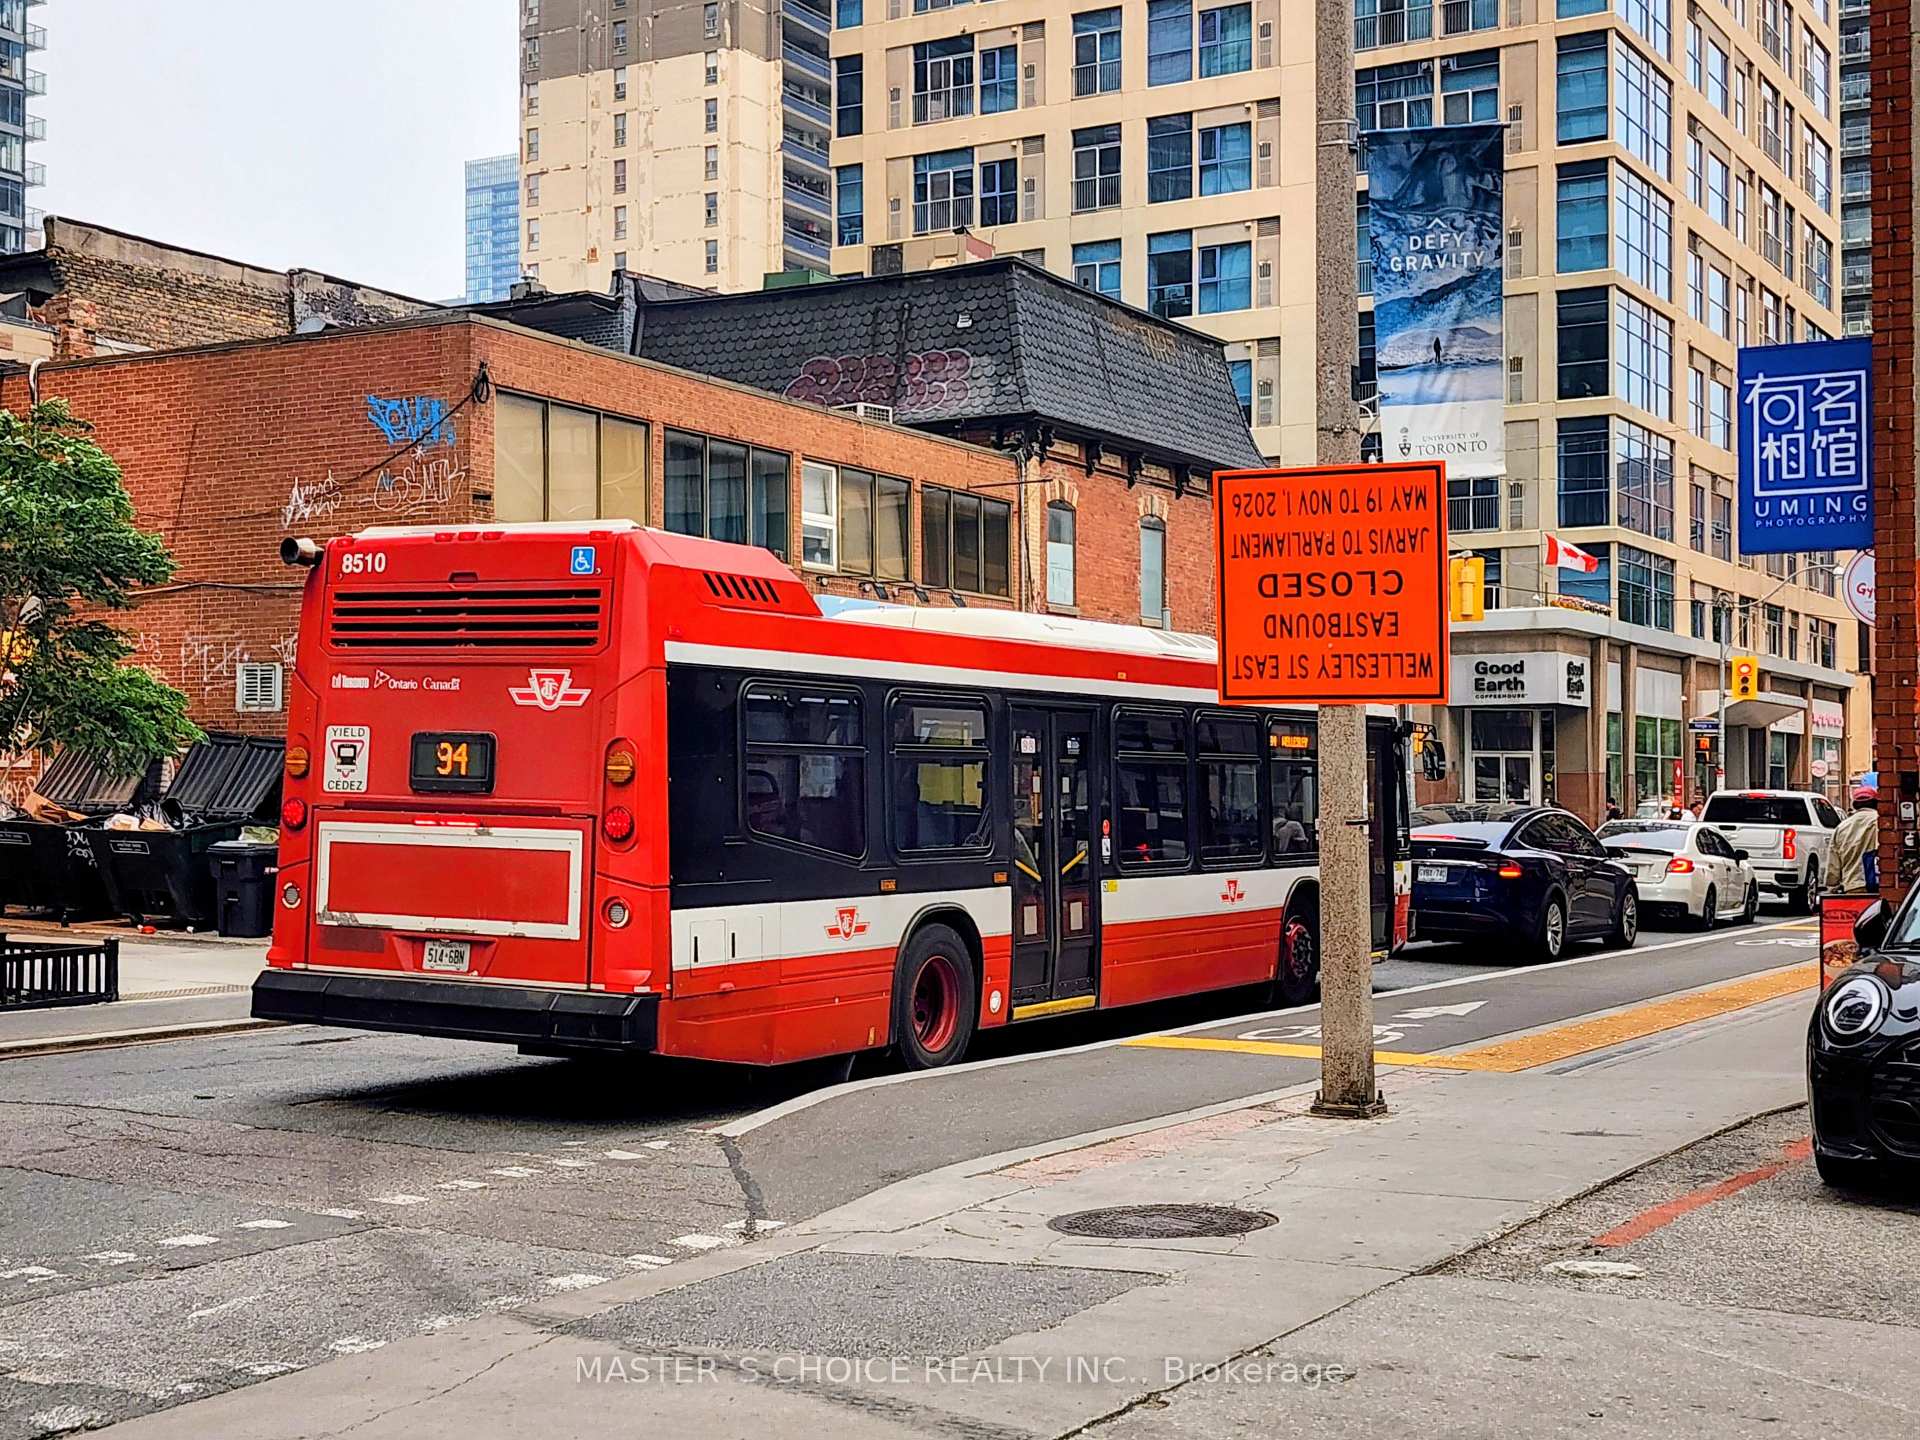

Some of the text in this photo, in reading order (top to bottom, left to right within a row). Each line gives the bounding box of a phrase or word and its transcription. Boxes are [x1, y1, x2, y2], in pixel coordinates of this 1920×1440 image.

[1409, 232, 1464, 251] DEFY
[1390, 251, 1485, 272] GRAVITY
[1422, 431, 1479, 442] UNIVERSITY OF
[1416, 440, 1488, 456] TORONTO
[1232, 491, 1277, 518] 2026
[1298, 489, 1332, 516] NOV
[1339, 488, 1360, 514] TO
[1366, 487, 1383, 513] 19
[1390, 485, 1427, 512] MAY
[1755, 494, 1868, 517] UMING
[1755, 514, 1868, 528] PHOTOGRAPHY
[1231, 527, 1430, 559] JARVIS TO PARLIAMENT
[341, 552, 386, 574] 8510
[1257, 569, 1404, 598] CLOSED
[1264, 611, 1399, 639] EASTBOUND
[1232, 652, 1434, 680] WELLESLEY ST EAST
[1474, 660, 1525, 675] Good
[388, 678, 418, 690] Ontario
[422, 676, 460, 691] Canada
[1474, 676, 1525, 692] Earth
[331, 727, 366, 738] YIELD
[436, 742, 469, 776] 94
[327, 778, 363, 791] CÉDEZ
